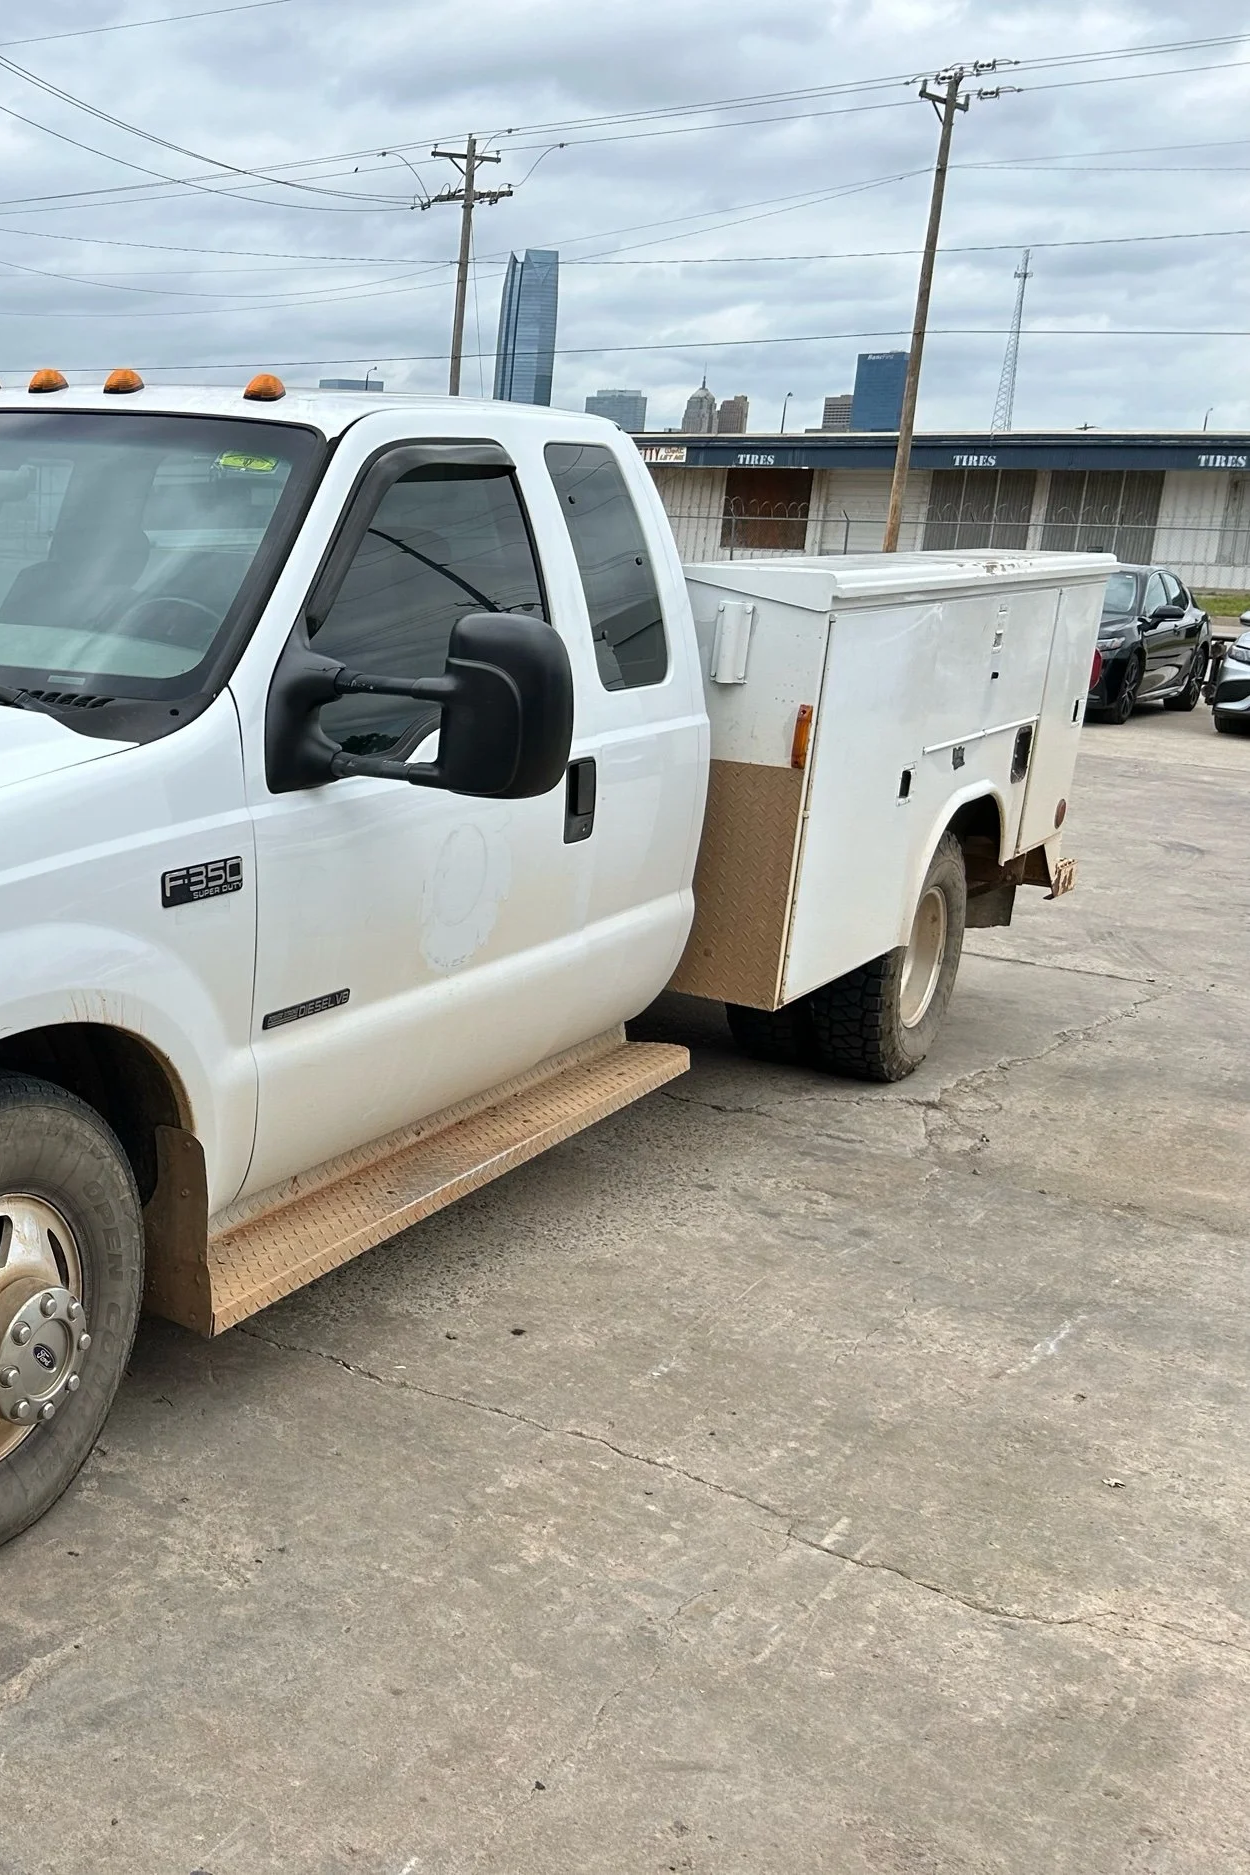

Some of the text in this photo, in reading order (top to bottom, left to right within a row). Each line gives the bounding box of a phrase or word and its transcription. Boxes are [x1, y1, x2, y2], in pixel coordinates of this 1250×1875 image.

[737, 453, 775, 466] TIRES
[952, 454, 997, 467] TIRES
[1197, 454, 1248, 468] TIRES
[192, 881, 243, 899] SUPER DUTY
[298, 997, 334, 1018] DIESEL
[335, 990, 349, 1005] V8
[82, 1179, 124, 1283] OPEN
[36, 1349, 52, 1367] Ford
